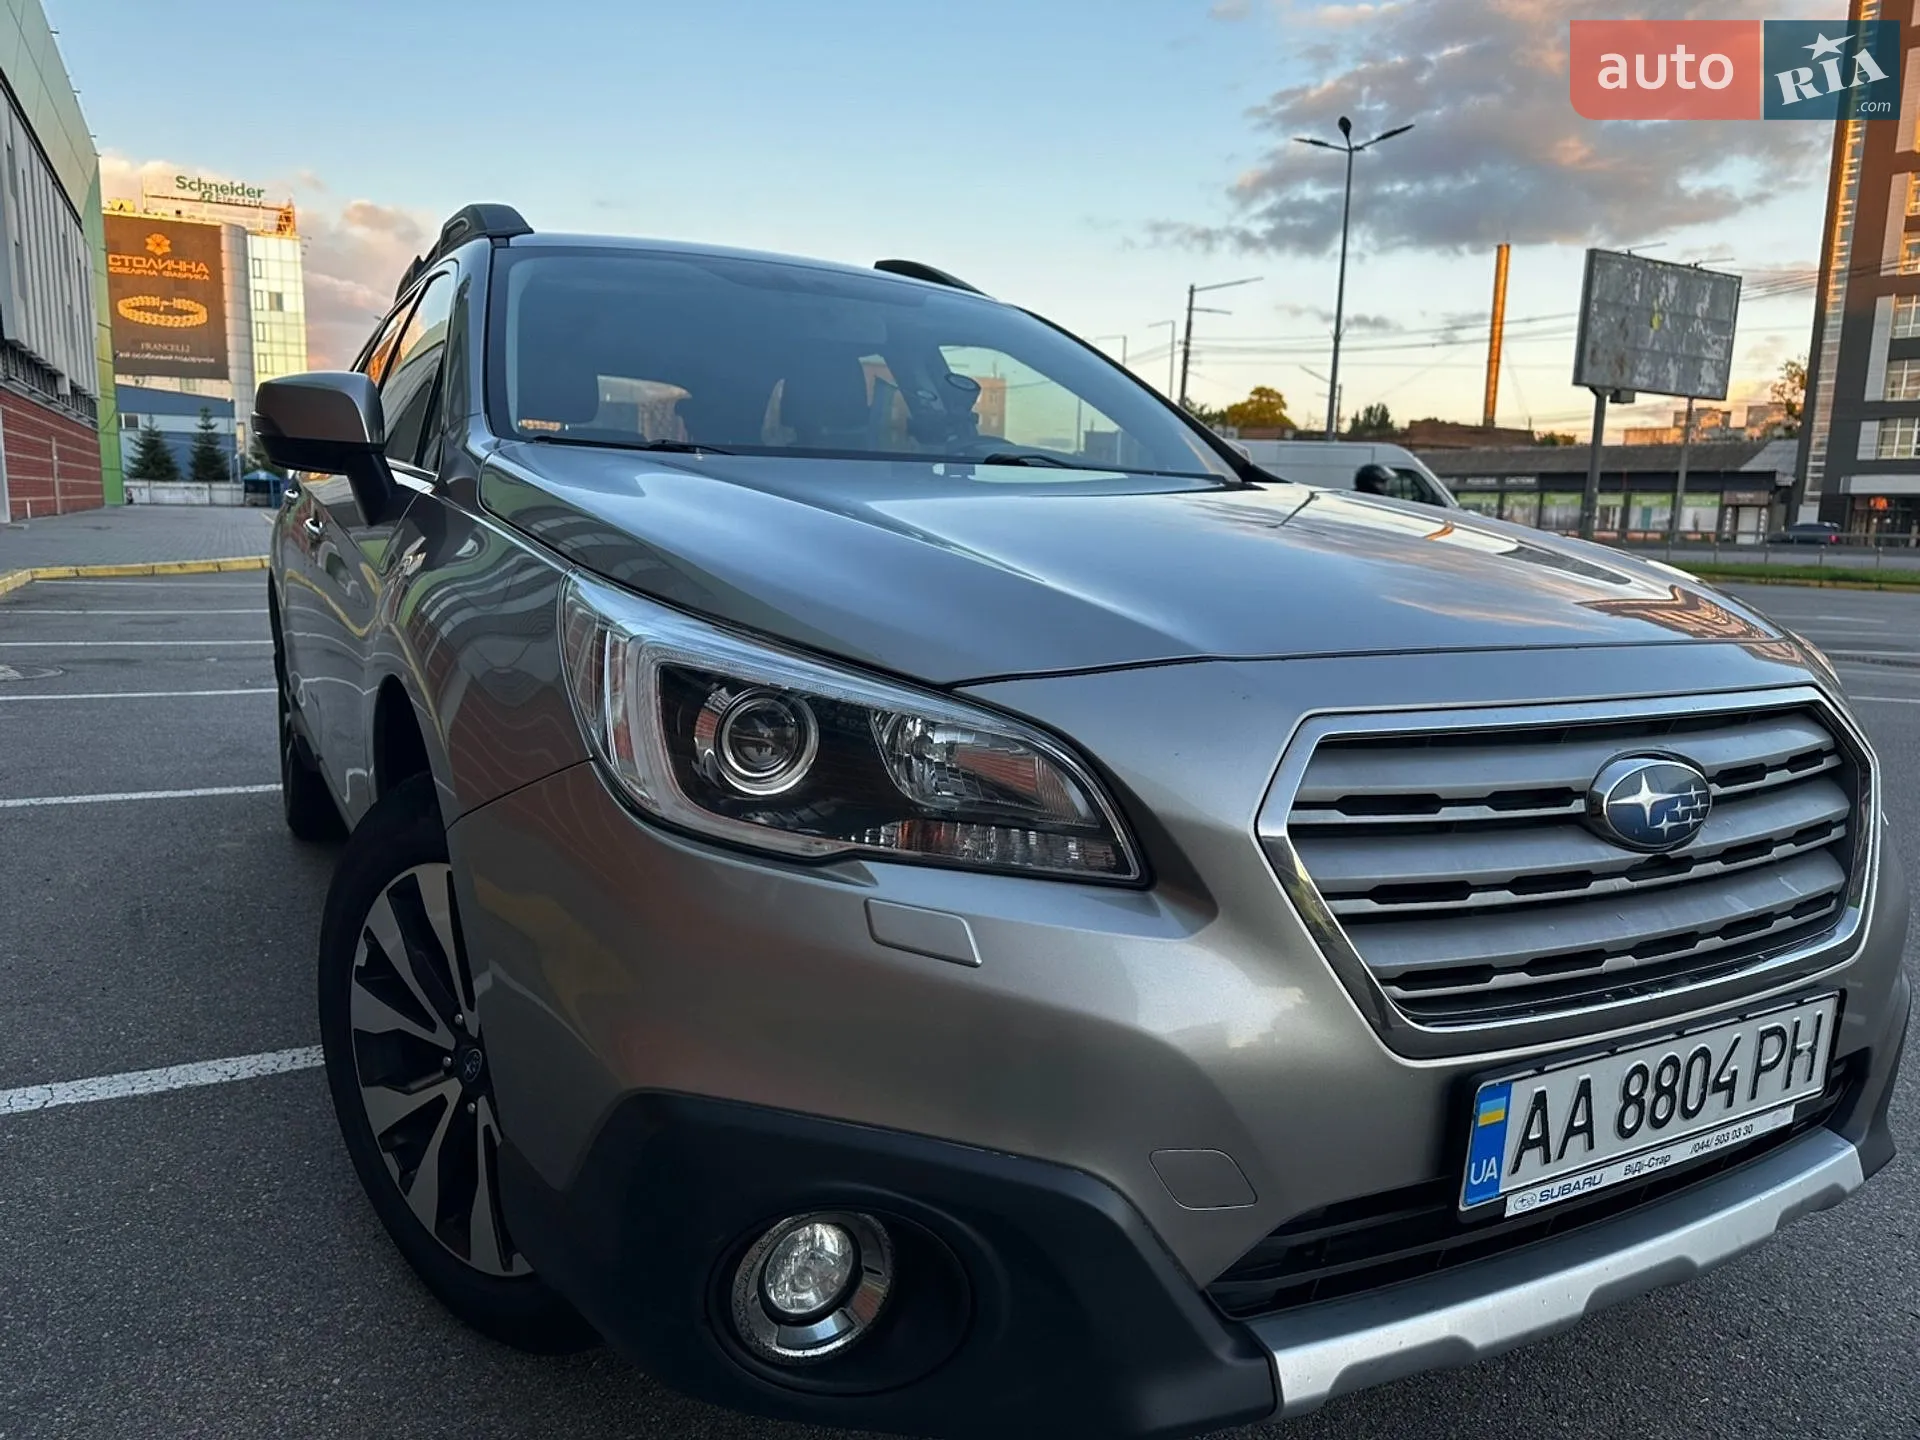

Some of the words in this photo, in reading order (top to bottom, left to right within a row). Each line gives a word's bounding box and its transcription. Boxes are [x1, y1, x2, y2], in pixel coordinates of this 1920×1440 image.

[175, 175, 265, 199] Schneider
[108, 254, 209, 274] СТОЛИЧНА
[1508, 1076, 1595, 1176] AA
[1617, 1033, 1742, 1140] 8804
[1749, 1010, 1823, 1101] PH
[1469, 1160, 1498, 1186] UA
[1539, 1174, 1604, 1203] SUBARU
